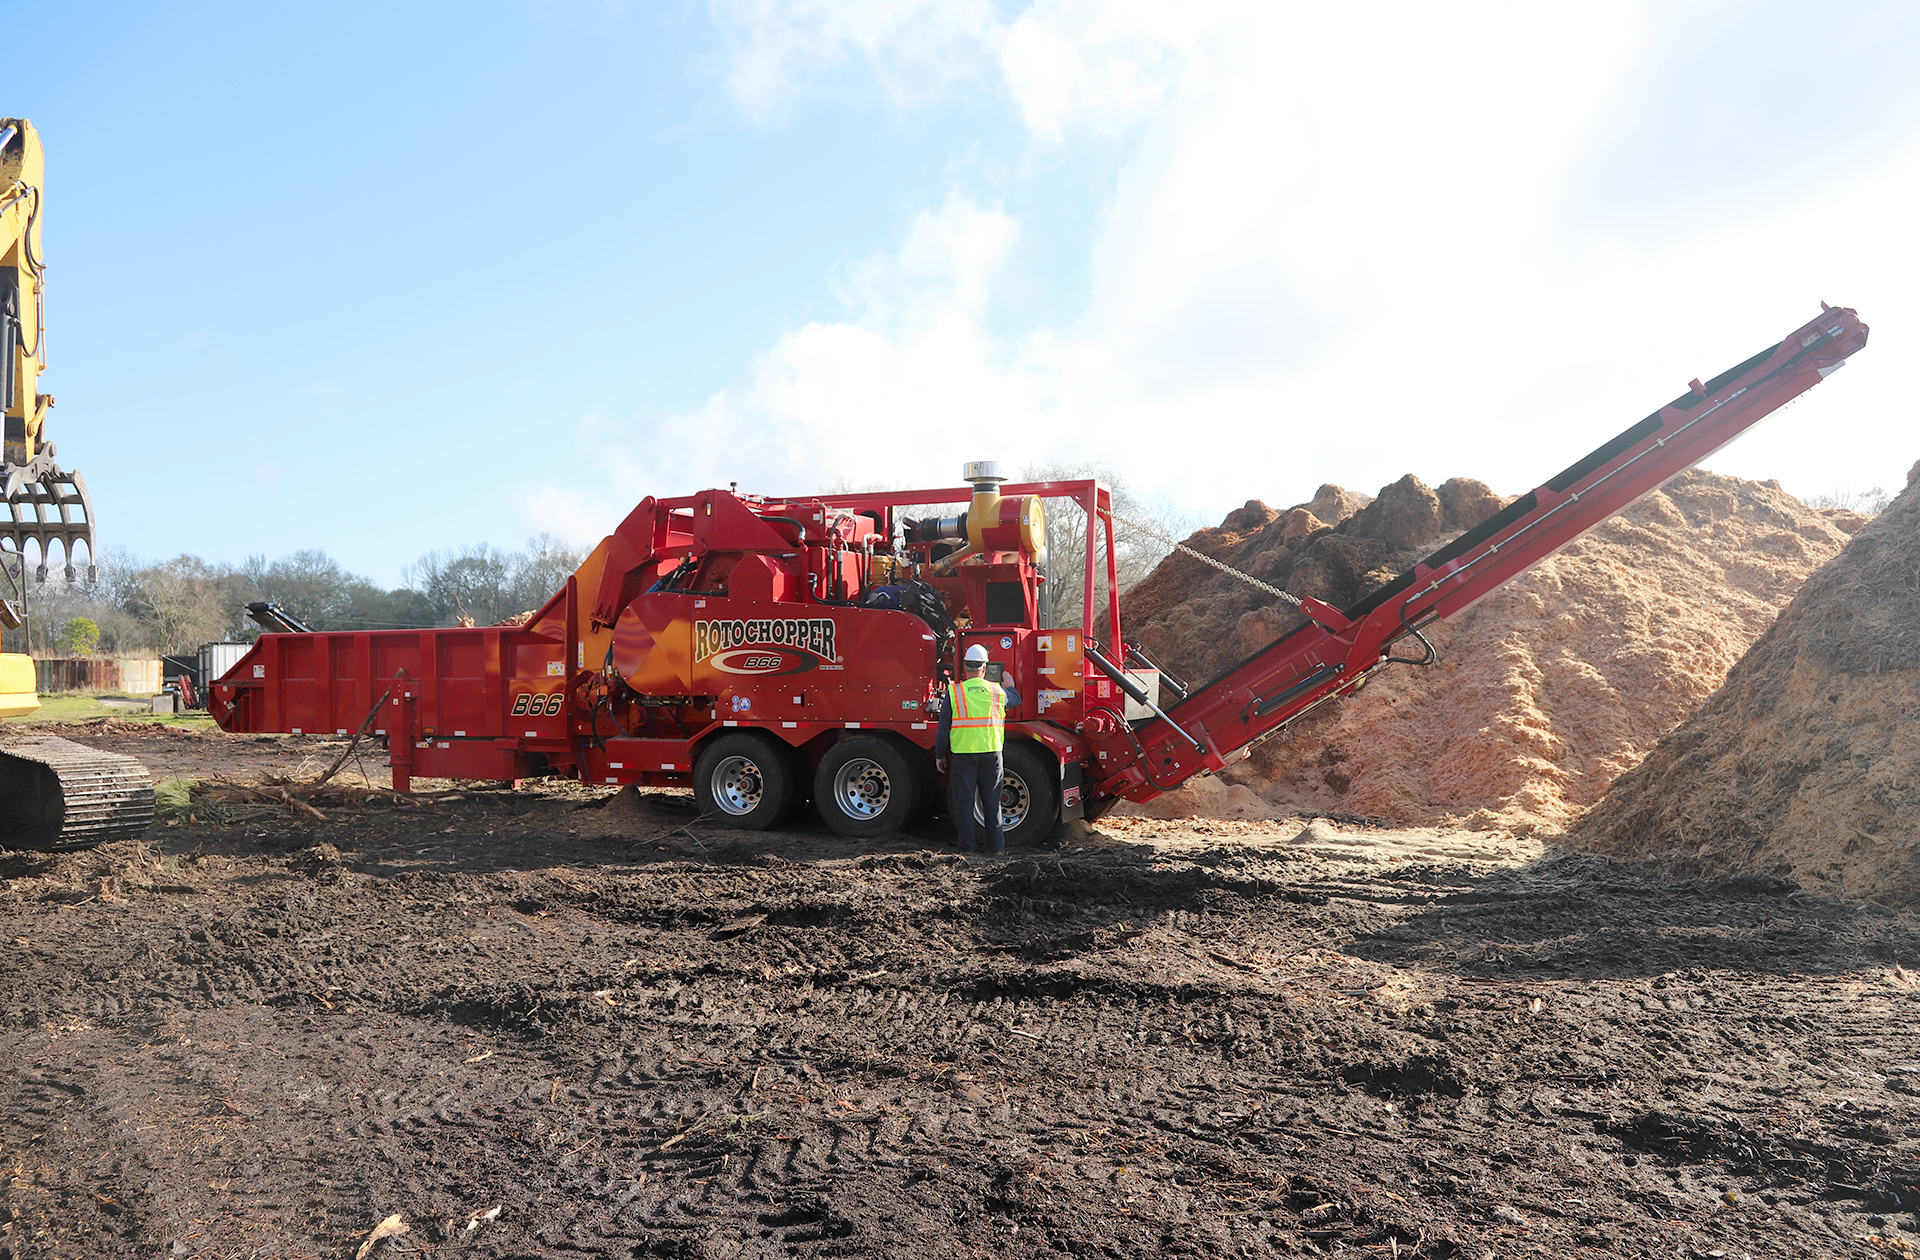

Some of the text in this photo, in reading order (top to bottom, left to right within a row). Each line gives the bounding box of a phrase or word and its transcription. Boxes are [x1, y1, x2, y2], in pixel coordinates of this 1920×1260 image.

[695, 618, 836, 663] ROTOCHOPPER
[743, 657, 782, 668] B66
[510, 693, 565, 716] B66
